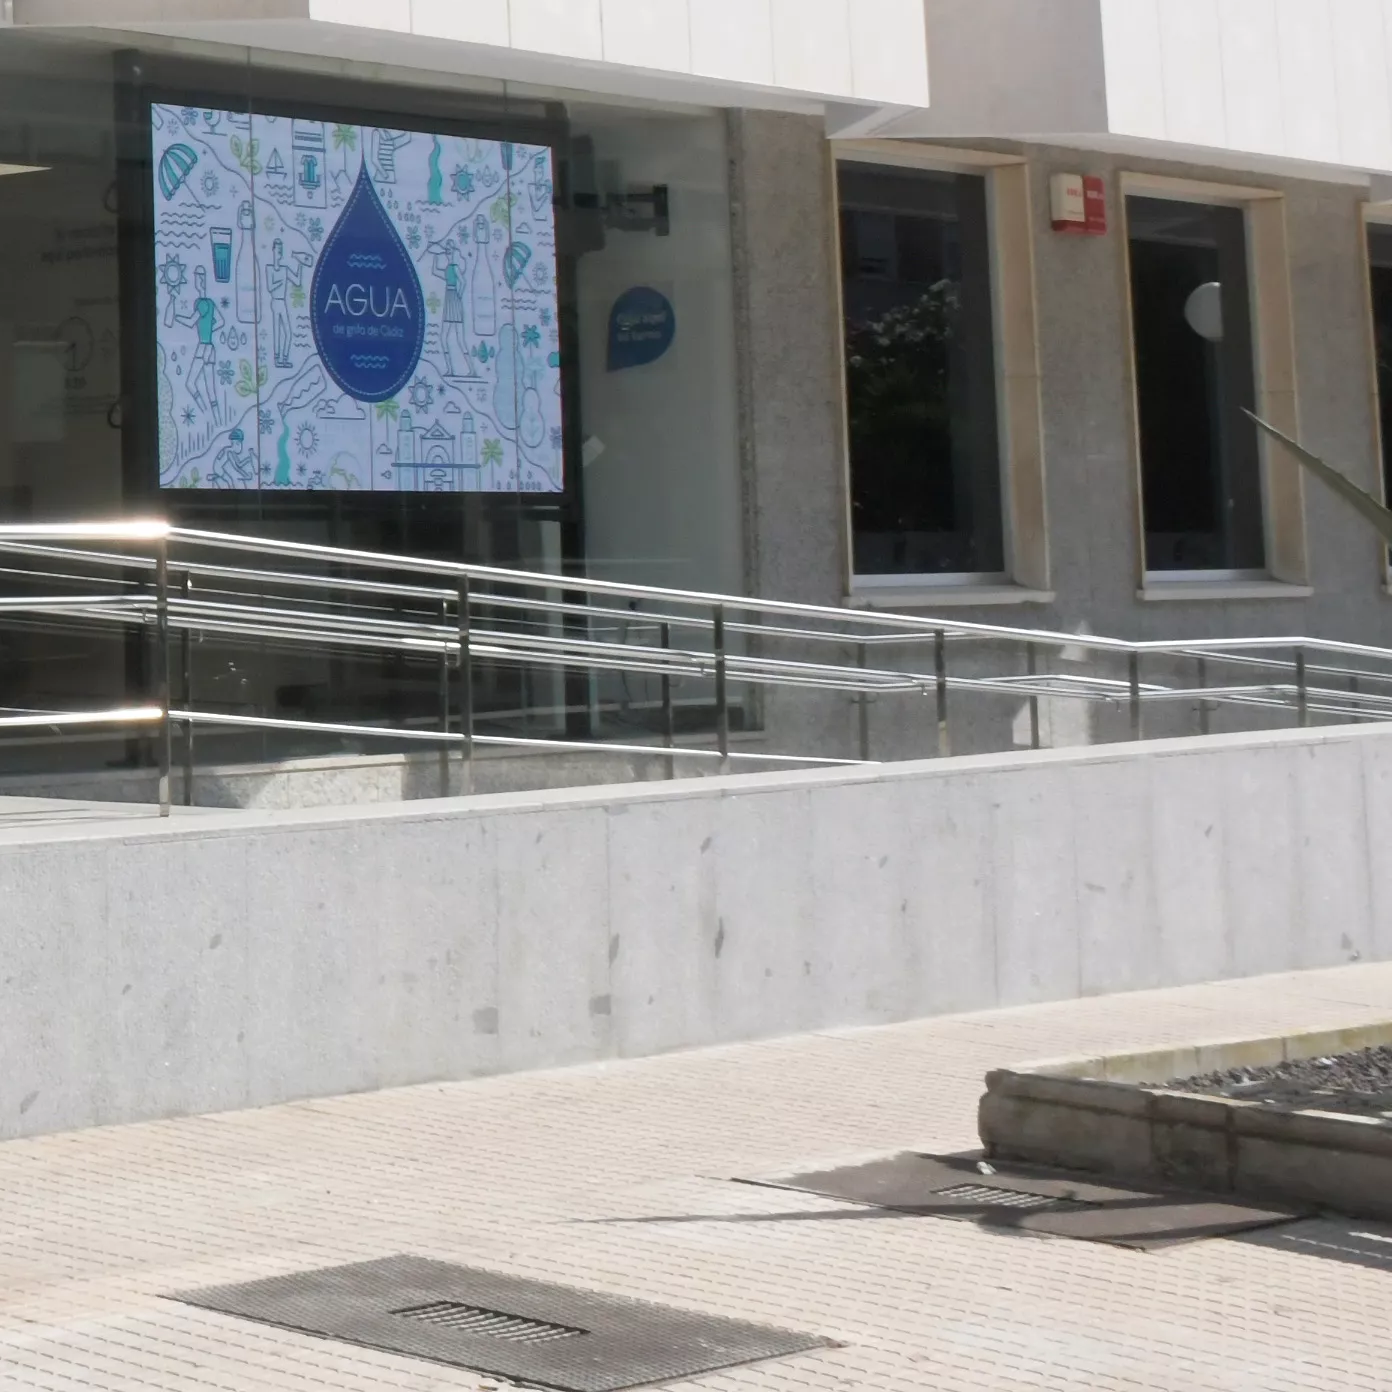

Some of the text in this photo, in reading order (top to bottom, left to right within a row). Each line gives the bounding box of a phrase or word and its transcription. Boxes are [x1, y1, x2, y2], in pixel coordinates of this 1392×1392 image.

[324, 284, 411, 319] AGUA
[333, 325, 344, 334] de
[367, 326, 378, 335] de
